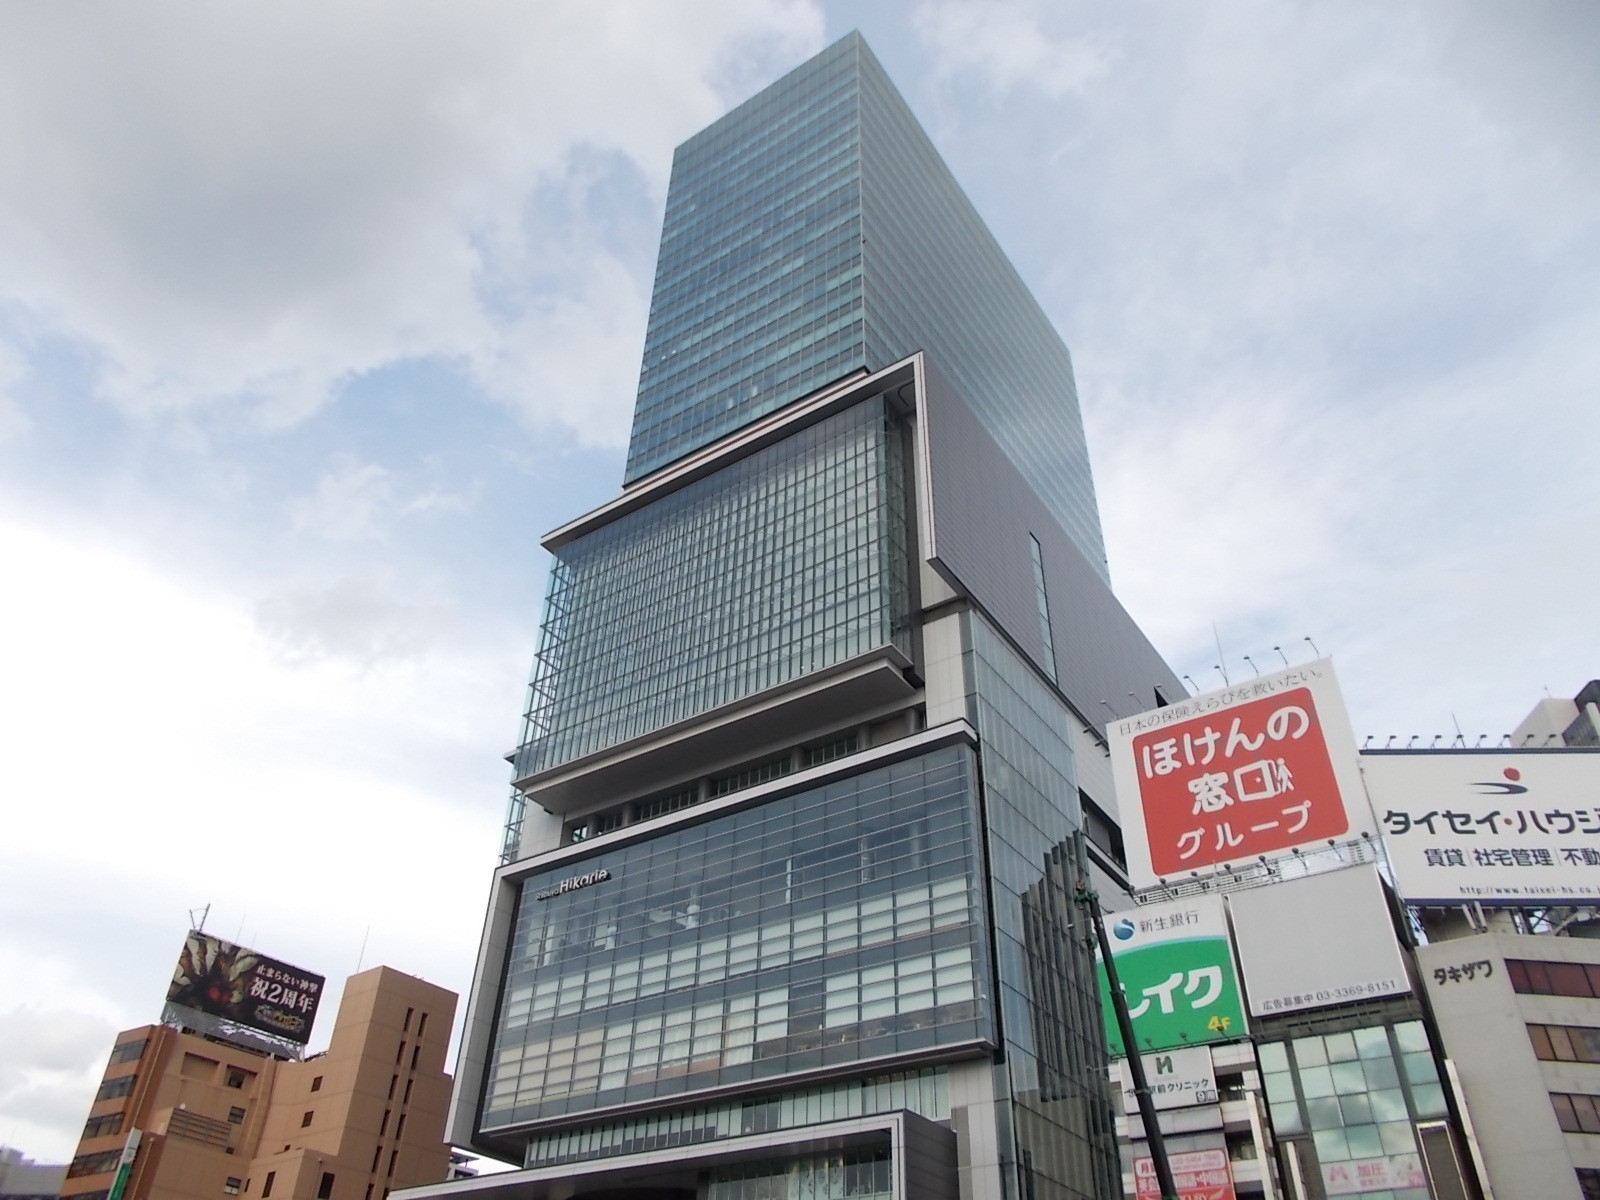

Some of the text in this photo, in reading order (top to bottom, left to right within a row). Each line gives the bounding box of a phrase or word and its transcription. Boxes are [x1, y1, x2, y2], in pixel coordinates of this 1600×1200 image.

[1142, 705, 1310, 779] ほけんの
[1187, 758, 1277, 815] 窓口
[1176, 799, 1313, 860] グループ
[1424, 848, 1467, 867] 賃貸
[1474, 848, 1555, 867] 社宅管理
[559, 868, 608, 893] Hikarie
[1139, 909, 1200, 933] 新生銀行
[1433, 959, 1494, 985] タキザワ
[250, 976, 315, 1013] 祝2周年
[1316, 979, 1396, 1001] 03-3369-8151
[1208, 1015, 1232, 1031] 4F
